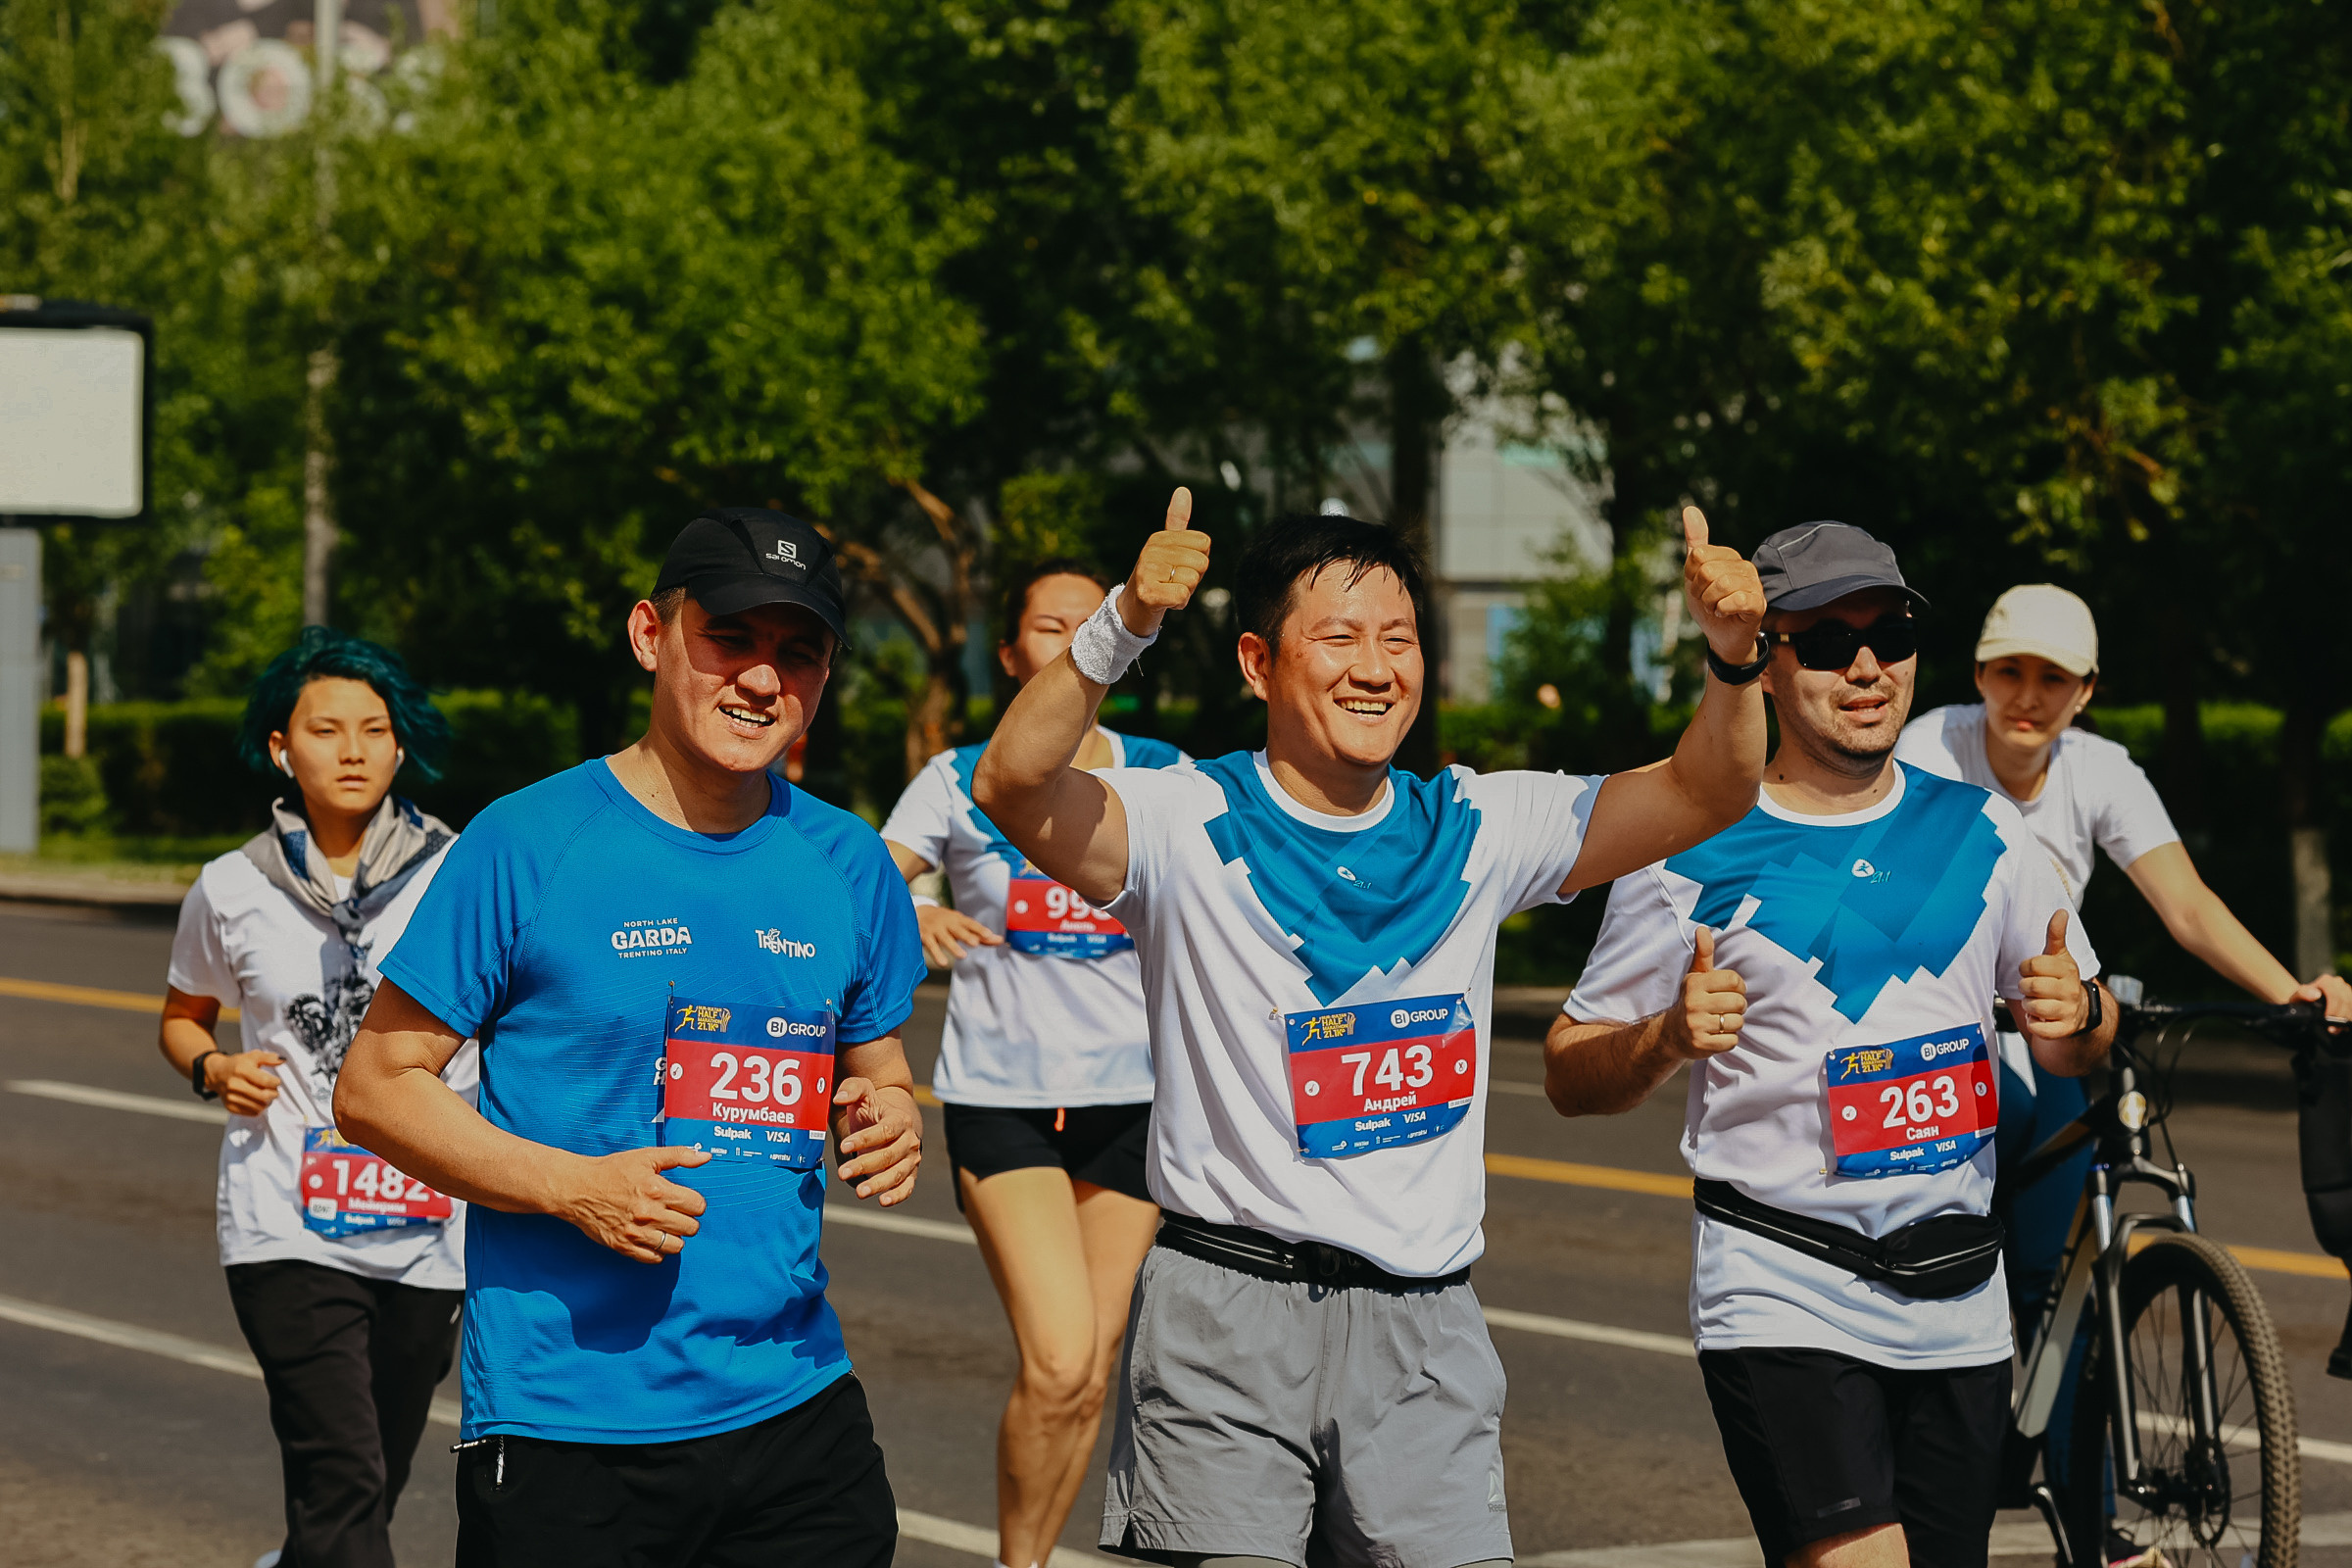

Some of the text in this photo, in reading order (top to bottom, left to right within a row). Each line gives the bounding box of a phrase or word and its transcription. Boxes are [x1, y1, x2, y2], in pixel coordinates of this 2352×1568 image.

[765, 553, 807, 570] salomon
[623, 917, 678, 928] NORTH LAKE
[611, 926, 693, 951] GARDA
[755, 928, 816, 960] TRENTINO
[618, 947, 688, 959] TRENTINO ITALY
[697, 1009, 718, 1019] HALF
[1322, 1017, 1344, 1027] HALF
[1395, 1008, 1448, 1024] BI GROUP
[770, 1021, 827, 1038] BI GROUP
[1861, 1053, 1883, 1061] HALF
[1924, 1039, 1970, 1057] BI GROUP
[709, 1052, 804, 1105] 236
[1341, 1045, 1434, 1097] 743
[1363, 1091, 1417, 1112] Андрей
[1880, 1075, 1959, 1129] 263
[712, 1102, 795, 1124] Курумбаев
[1354, 1111, 1427, 1132] Sulpak VISA
[713, 1125, 791, 1144] Sulpak VISA
[1906, 1126, 1939, 1141] Саян
[1889, 1140, 1957, 1161] Sulpak VISA
[332, 1159, 430, 1201] 1482
